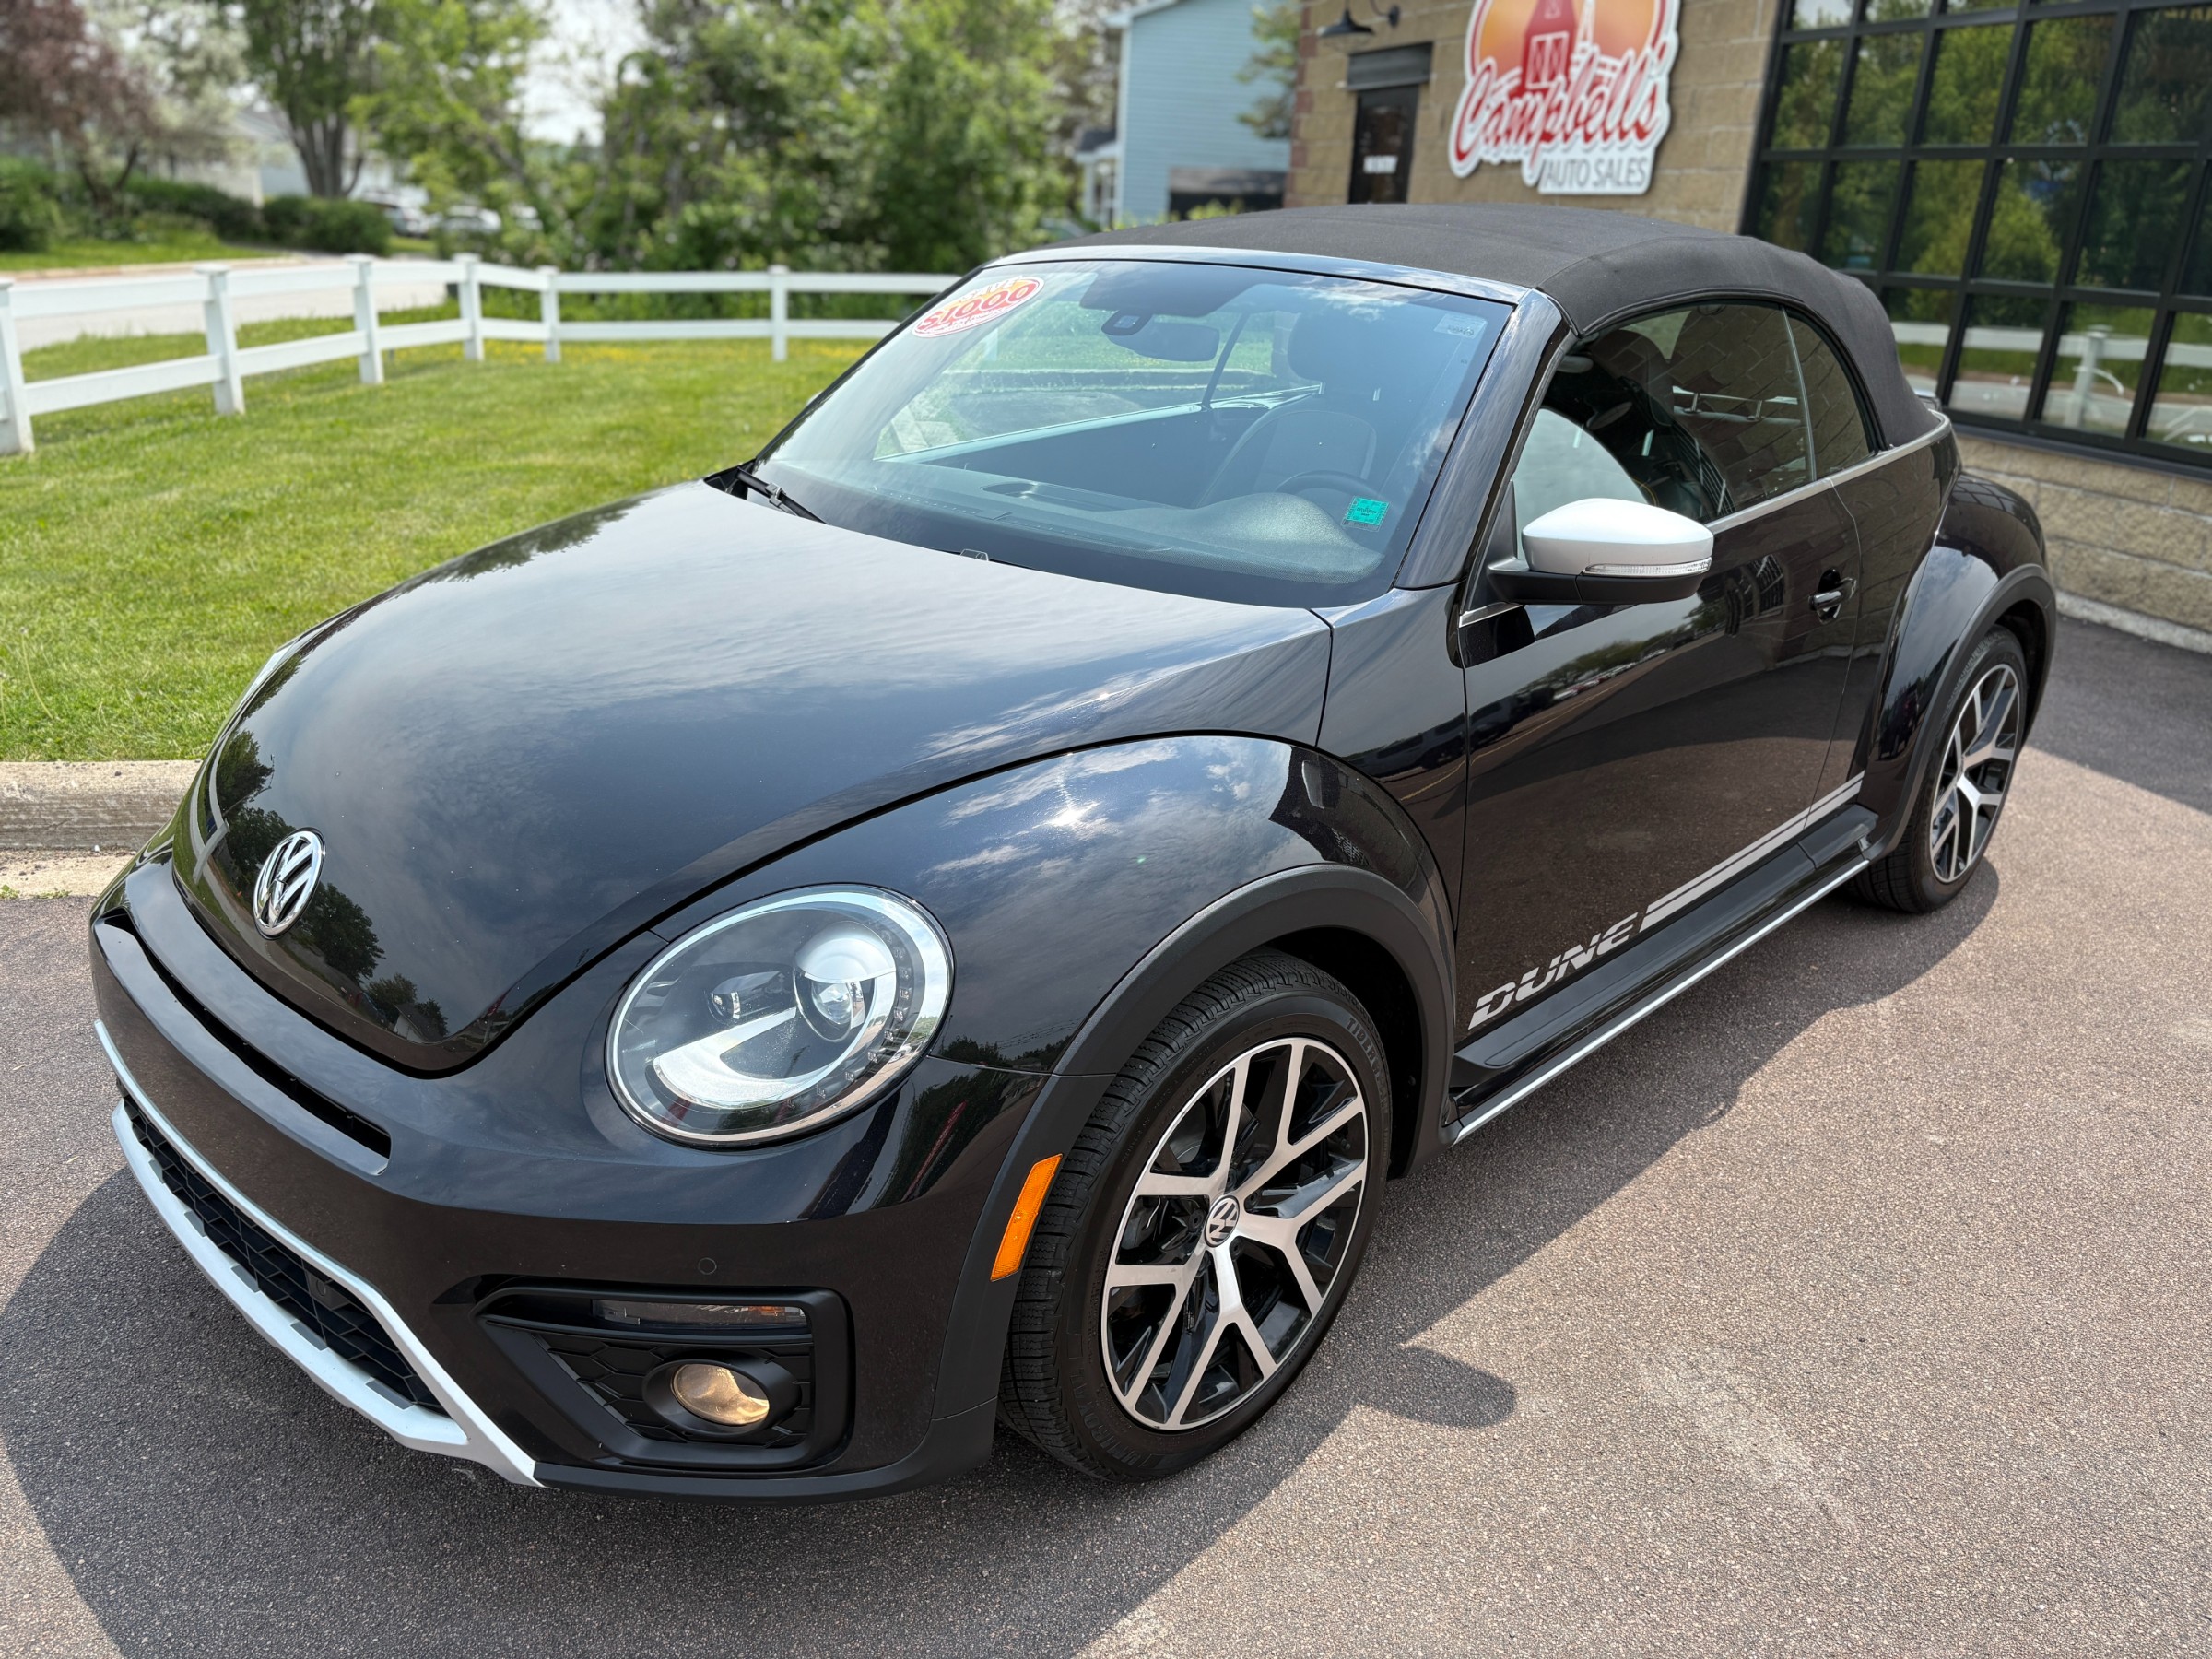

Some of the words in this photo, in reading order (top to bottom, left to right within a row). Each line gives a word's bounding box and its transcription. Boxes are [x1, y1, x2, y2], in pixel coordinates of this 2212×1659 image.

[1454, 41, 1666, 169] Campbell's
[1546, 159, 1591, 186] AUTO
[1593, 157, 1648, 186] SALES
[1468, 912, 1639, 1030] DUNE
